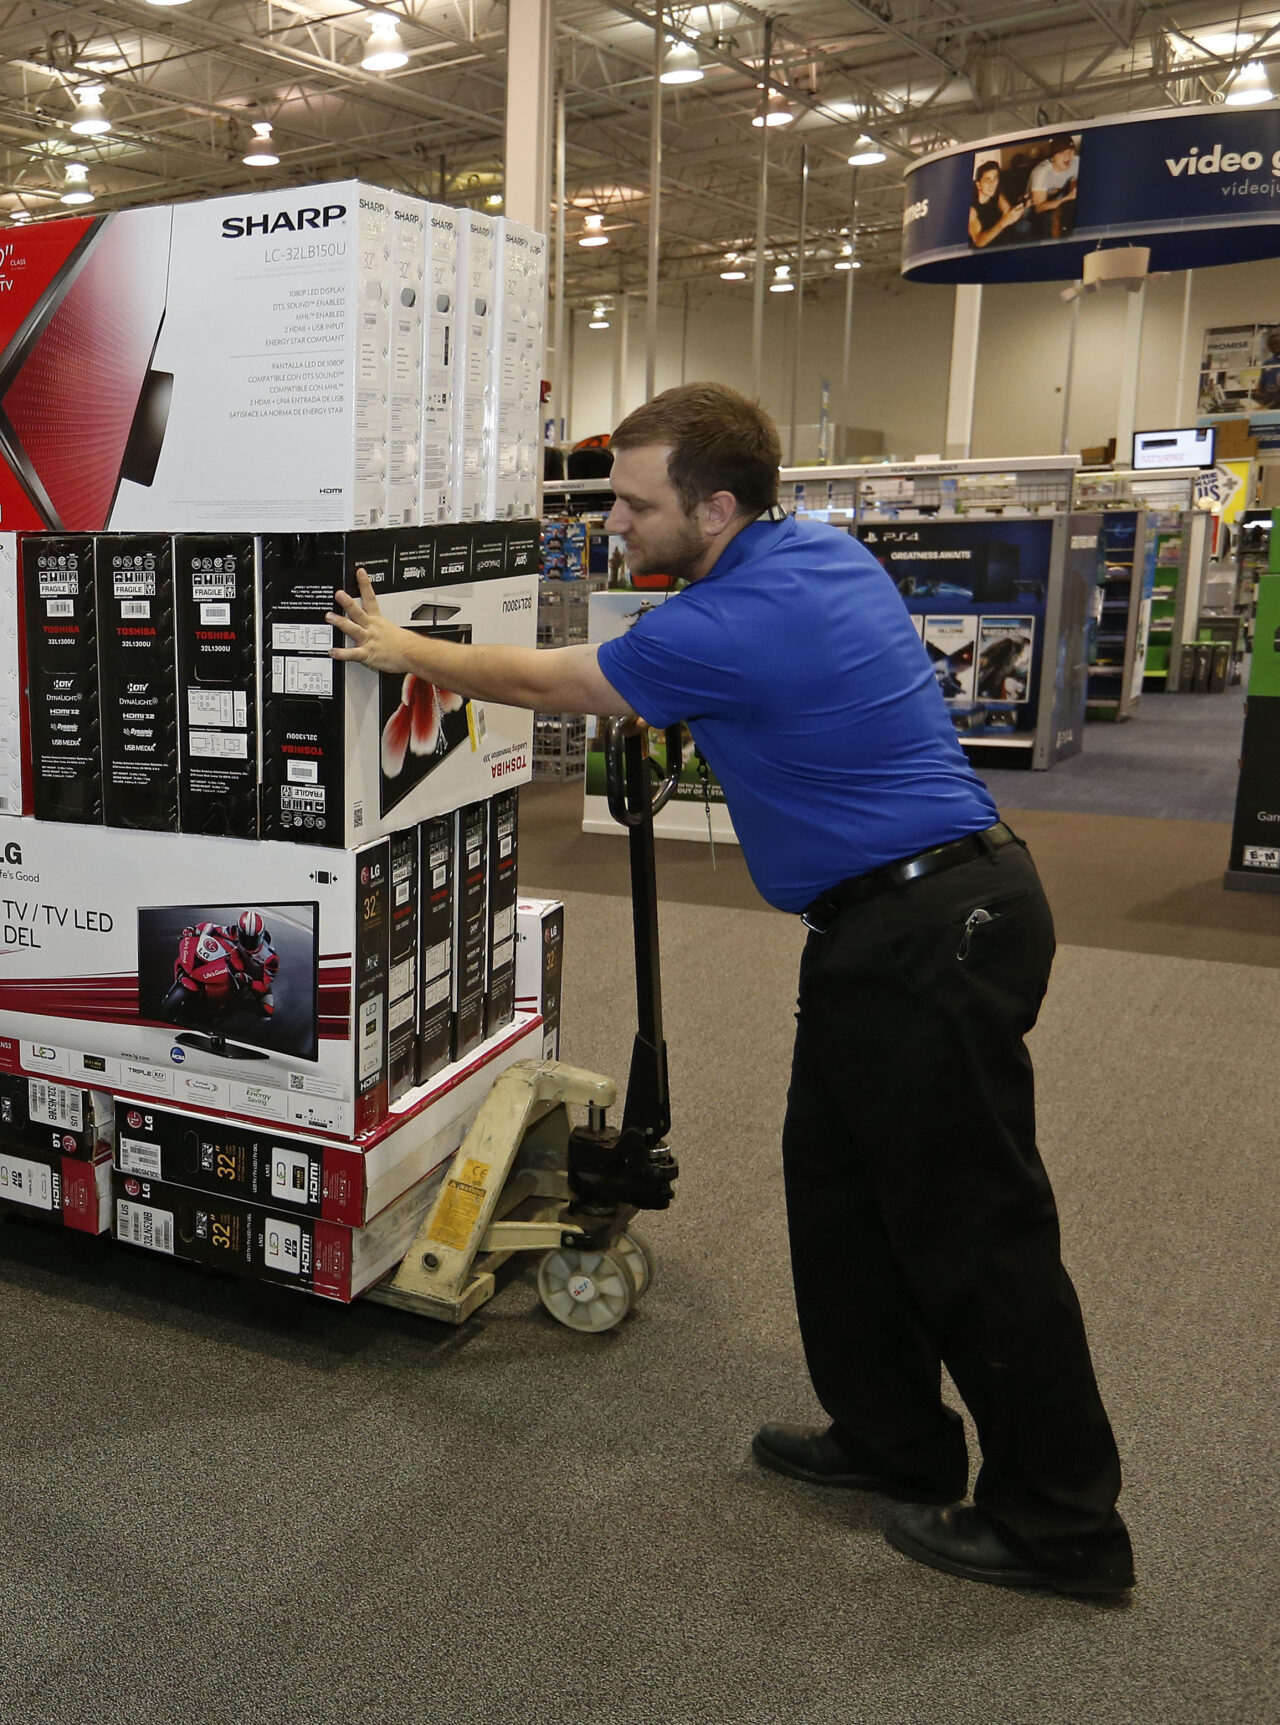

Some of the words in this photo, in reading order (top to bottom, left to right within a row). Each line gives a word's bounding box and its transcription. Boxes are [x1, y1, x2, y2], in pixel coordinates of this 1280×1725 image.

[1165, 144, 1263, 177] video
[359, 199, 384, 213] SHARP
[221, 205, 347, 239] SHARP
[394, 210, 419, 224] SHARP
[431, 218, 453, 231] SHARP
[470, 224, 490, 238] SHARP
[265, 242, 346, 264] LC-32LB150U
[0, 280, 13, 292] TV
[306, 334, 345, 344] COMPLIANT
[1207, 341, 1249, 350] PROMISE
[883, 532, 920, 542] PS4
[890, 551, 938, 560] GREATNESS
[938, 550, 972, 559] AWAITS
[41, 585, 67, 593] FRAGILE
[194, 588, 223, 596] FRAGILE
[42, 625, 80, 634] TOSHIBA
[115, 627, 157, 636] TOSHIBA
[195, 631, 236, 640] TOSHIBA
[281, 745, 323, 755] TOSHIBA
[491, 754, 527, 779] TOSHIBA
[294, 788, 323, 797] FRAGILE
[15, 871, 40, 883] Good
[370, 863, 380, 879] LG
[2, 899, 29, 922] TV
[41, 904, 69, 926] TV
[74, 909, 114, 934] LED
[4, 924, 42, 949] DEL
[550, 925, 558, 937] LG
[31, 1044, 56, 1060] LED
[171, 1053, 186, 1061] NCAA
[127, 1067, 152, 1077] TRIPLE
[360, 1073, 380, 1091] HDMI
[246, 1089, 272, 1101] Energy
[70, 1115, 78, 1127] US
[144, 1115, 154, 1131] LG
[52, 1133, 61, 1149] LG
[215, 1145, 236, 1181] 32"
[309, 1161, 319, 1203] HDMI
[142, 1183, 151, 1199] LG
[121, 1204, 129, 1216] US
[210, 1214, 231, 1249] 32"
[301, 1233, 311, 1274] HDMI
